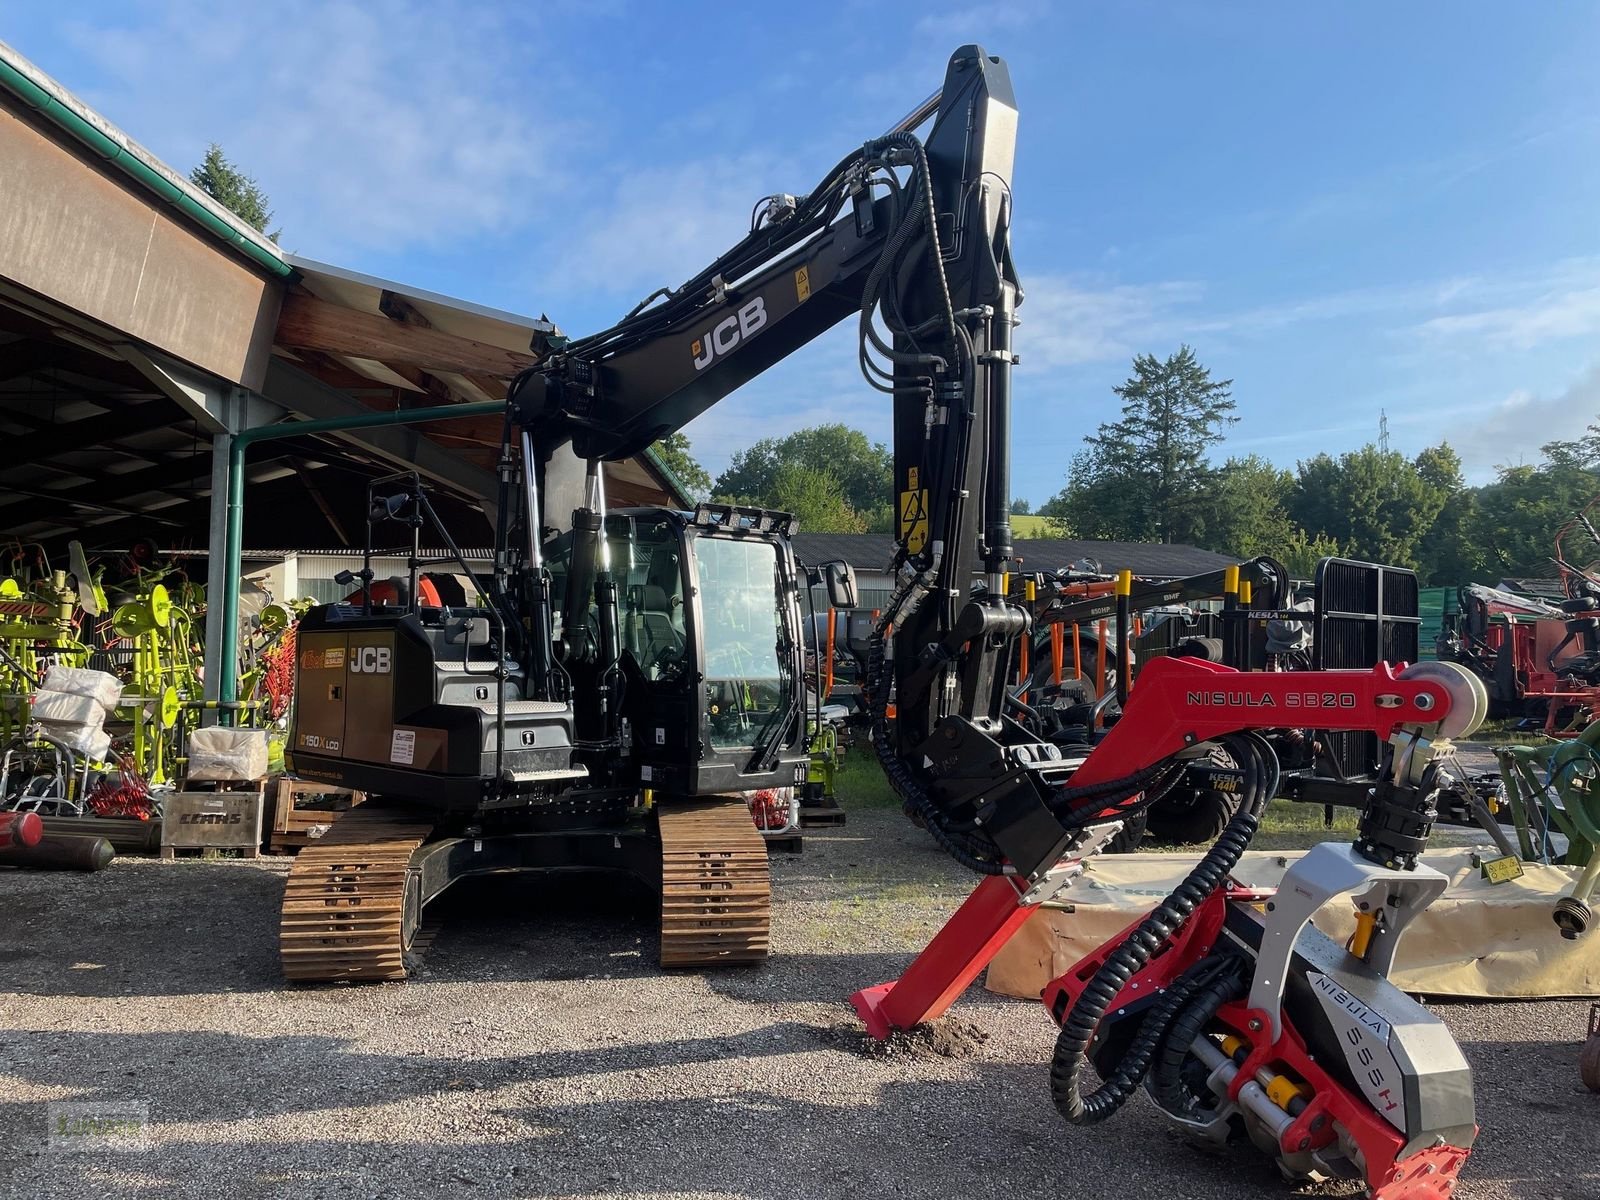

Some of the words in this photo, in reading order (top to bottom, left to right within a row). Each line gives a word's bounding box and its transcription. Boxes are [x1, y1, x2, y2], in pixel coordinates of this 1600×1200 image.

[692, 296, 768, 371] JCB
[1247, 611, 1279, 619] KESLA
[350, 647, 391, 673] JCB
[1187, 691, 1277, 707] NISULA
[1285, 692, 1356, 708] SB20
[1209, 773, 1244, 784] KESLA
[1315, 978, 1382, 1033] NISULA
